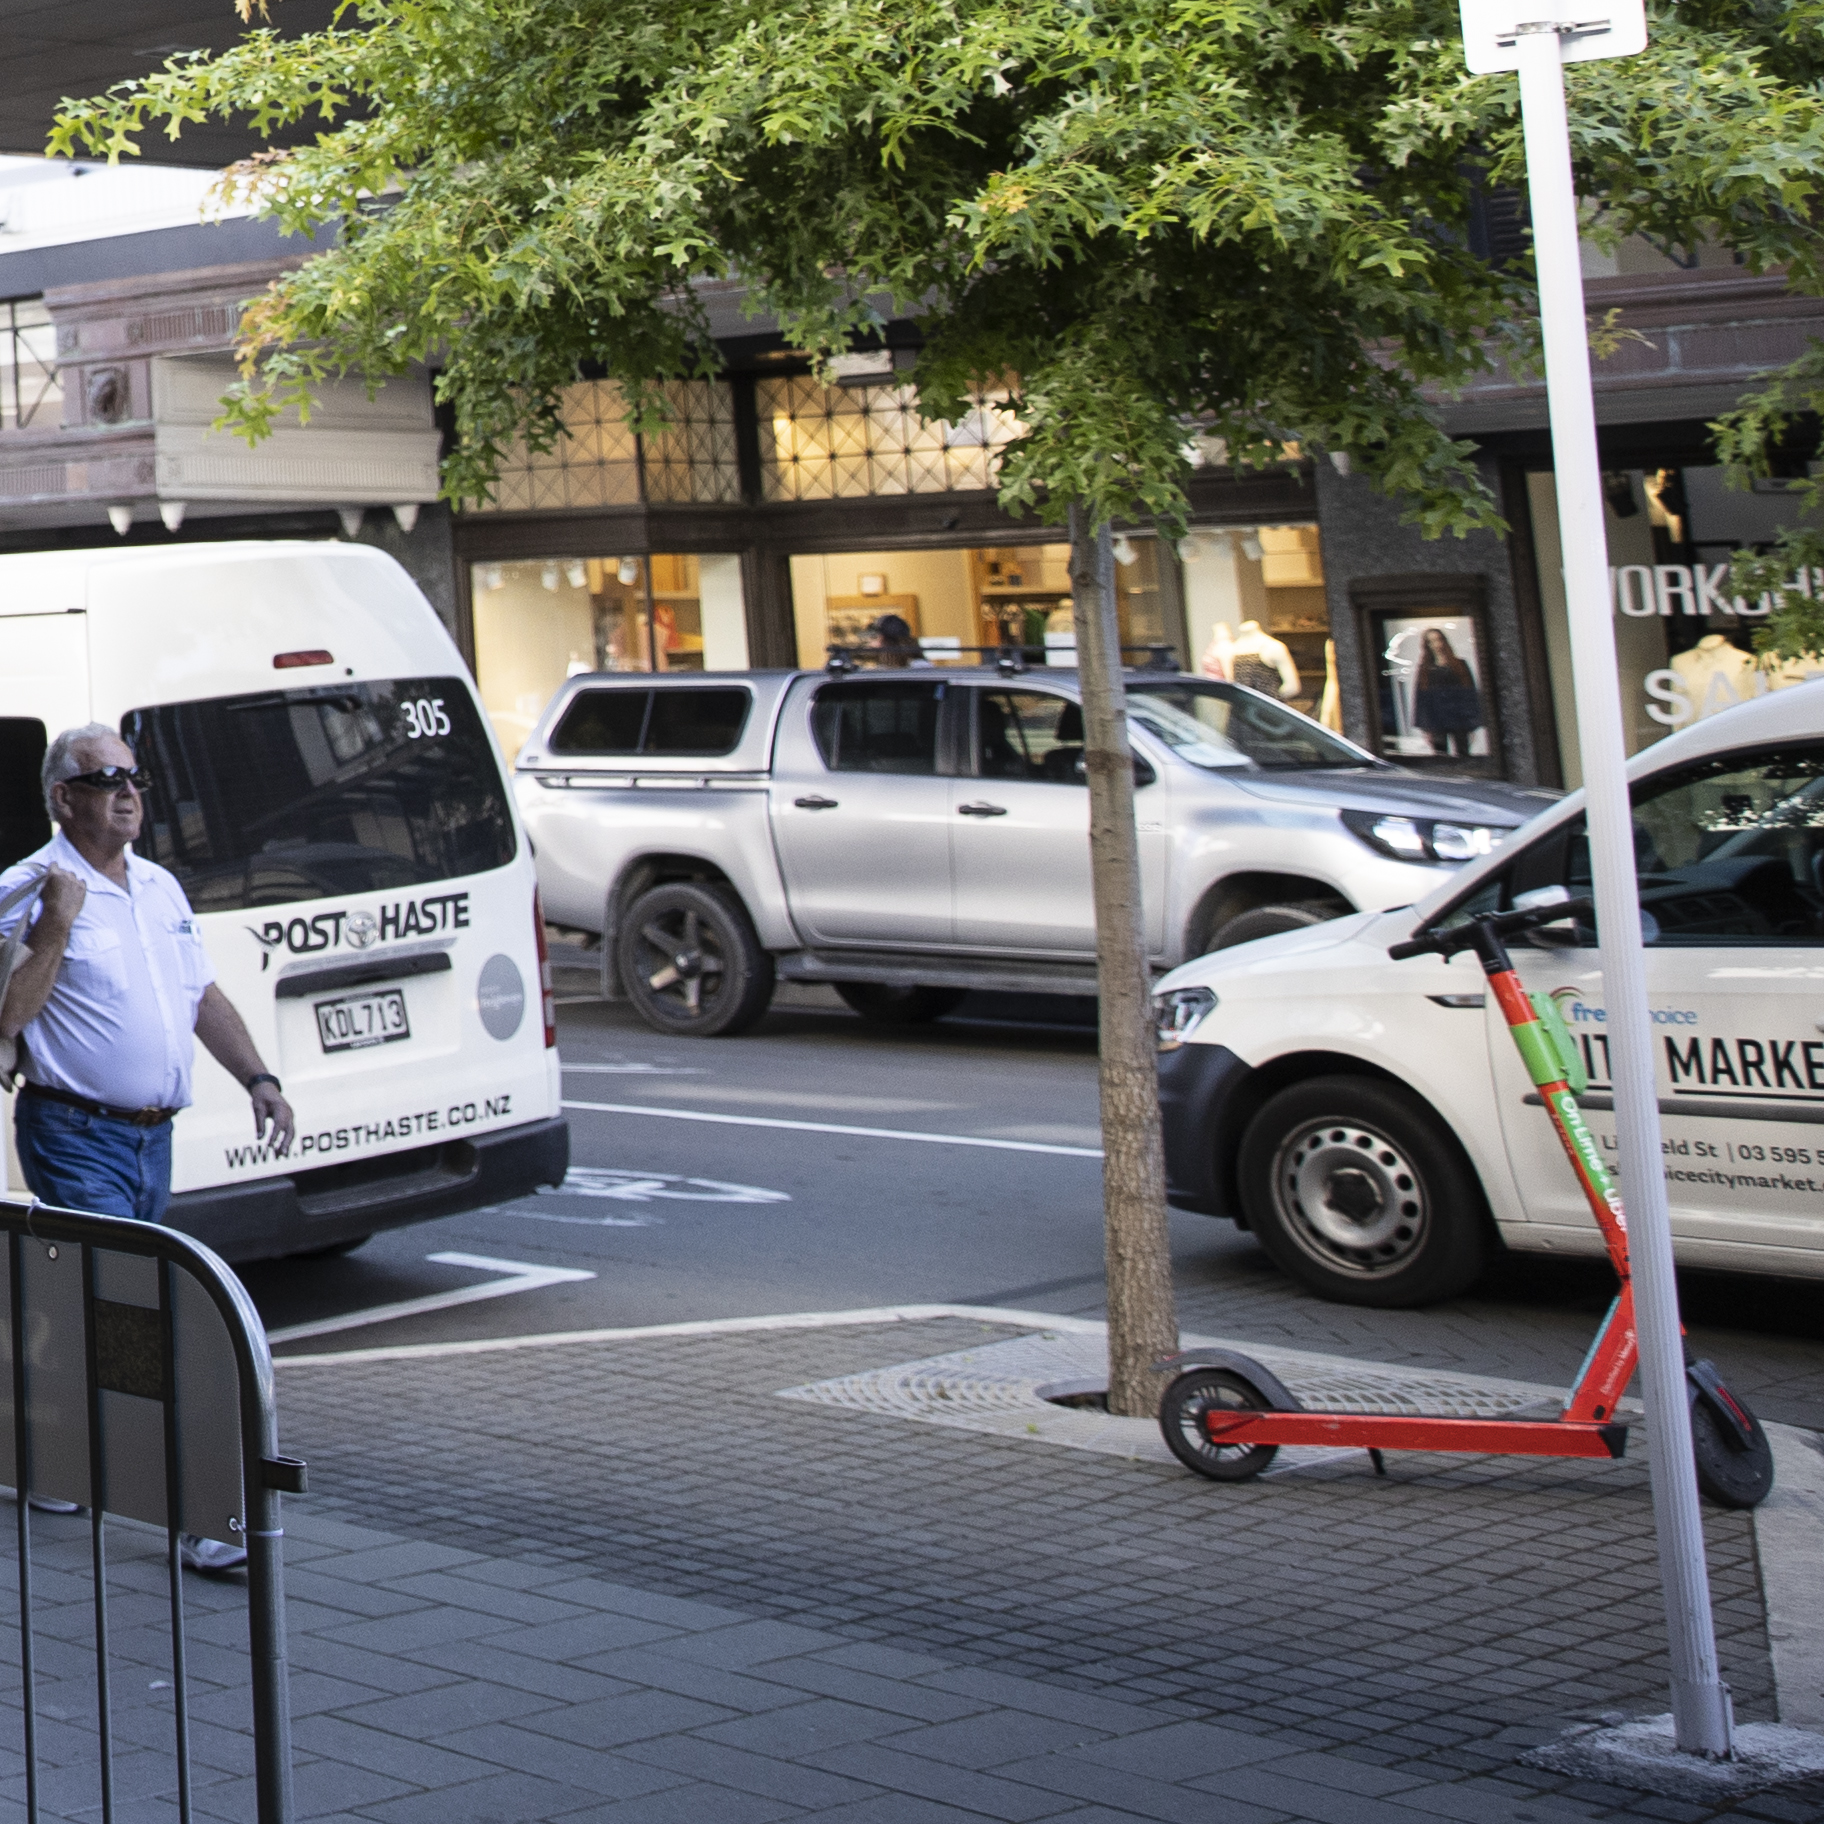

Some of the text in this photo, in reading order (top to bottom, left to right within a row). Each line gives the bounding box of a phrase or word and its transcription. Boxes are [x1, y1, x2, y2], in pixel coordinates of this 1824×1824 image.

[401, 699, 451, 739] 305
[261, 891, 470, 972] POST HASTE
[320, 1000, 406, 1045] KDL713
[224, 1094, 513, 1169] WWW.POSTHASTE.CO.NZ
[1695, 1141, 1717, 1158] St
[1739, 1145, 1766, 1160] 03
[1771, 1147, 1811, 1164] 595
